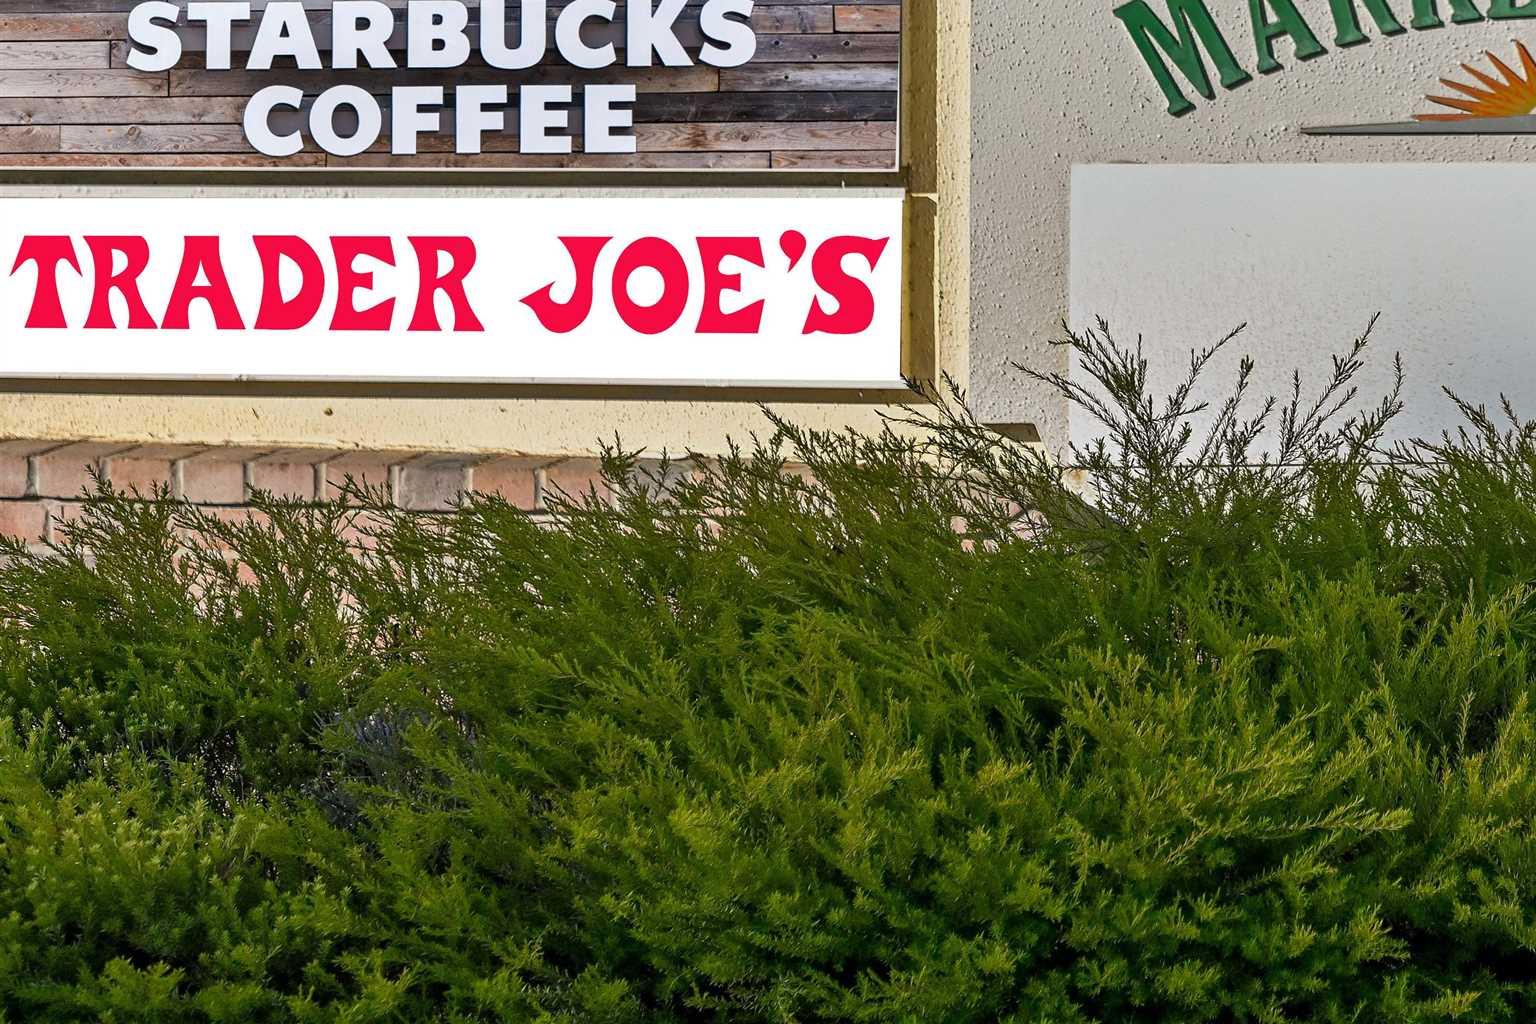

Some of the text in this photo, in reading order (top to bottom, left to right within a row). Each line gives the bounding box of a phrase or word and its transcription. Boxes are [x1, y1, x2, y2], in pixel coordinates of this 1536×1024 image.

[242, 84, 638, 158] COFFEE
[9, 229, 890, 336] TRADER JOE'S
